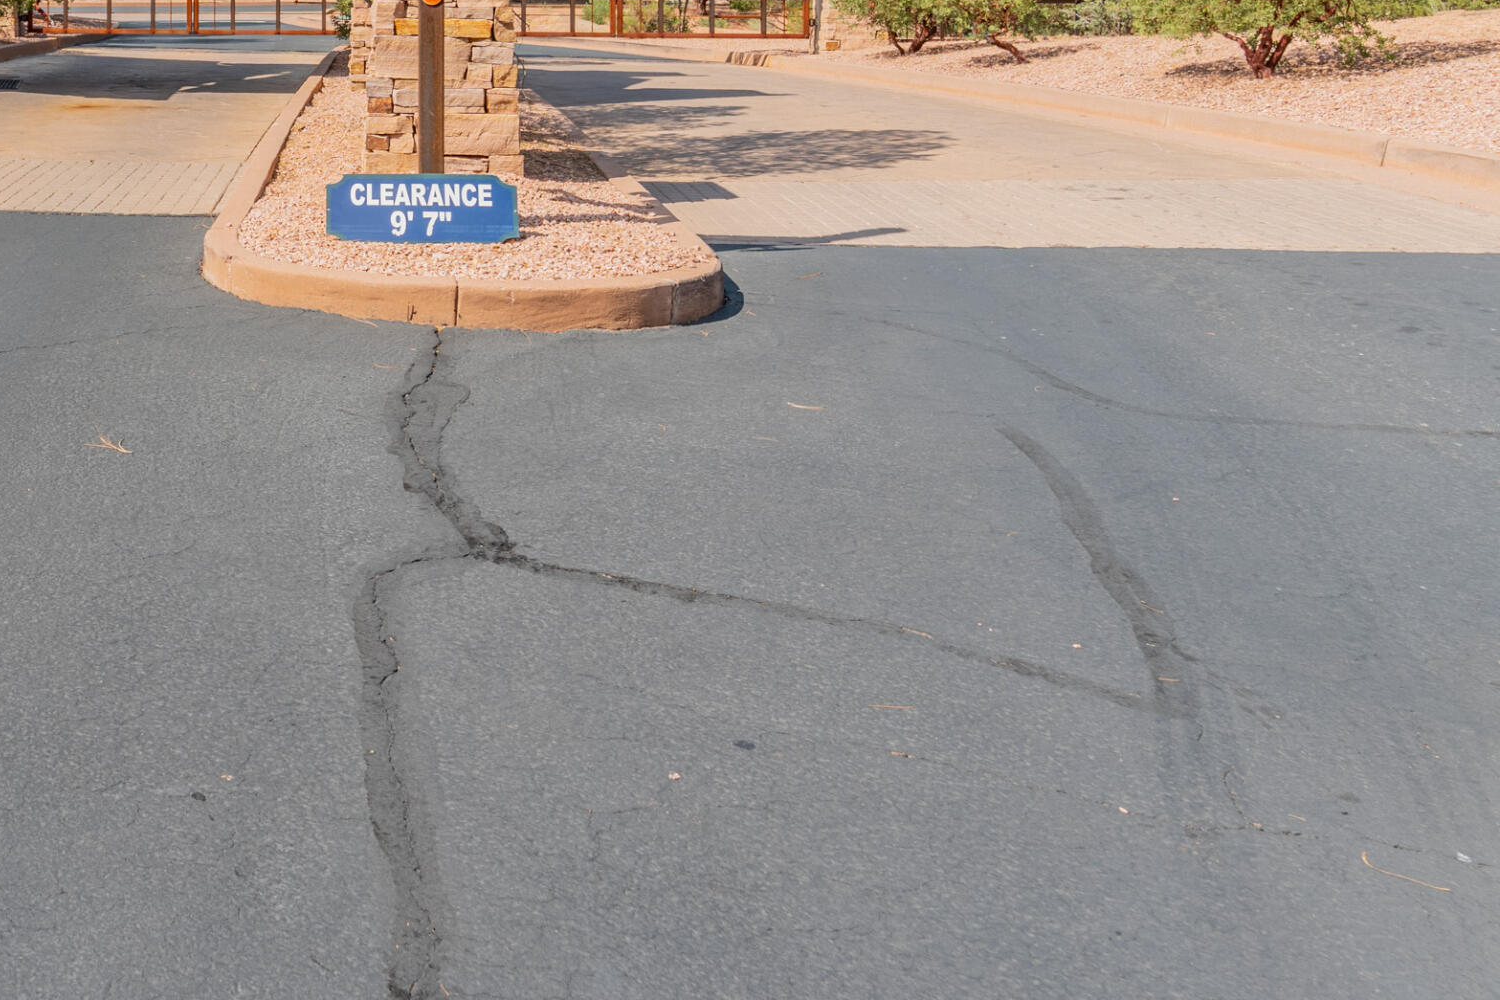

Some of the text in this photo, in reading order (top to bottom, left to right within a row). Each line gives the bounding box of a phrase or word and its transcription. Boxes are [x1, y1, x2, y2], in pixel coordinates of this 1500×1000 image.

[350, 183, 493, 207] CLEARANCE
[390, 210, 452, 237] 9' 7"
